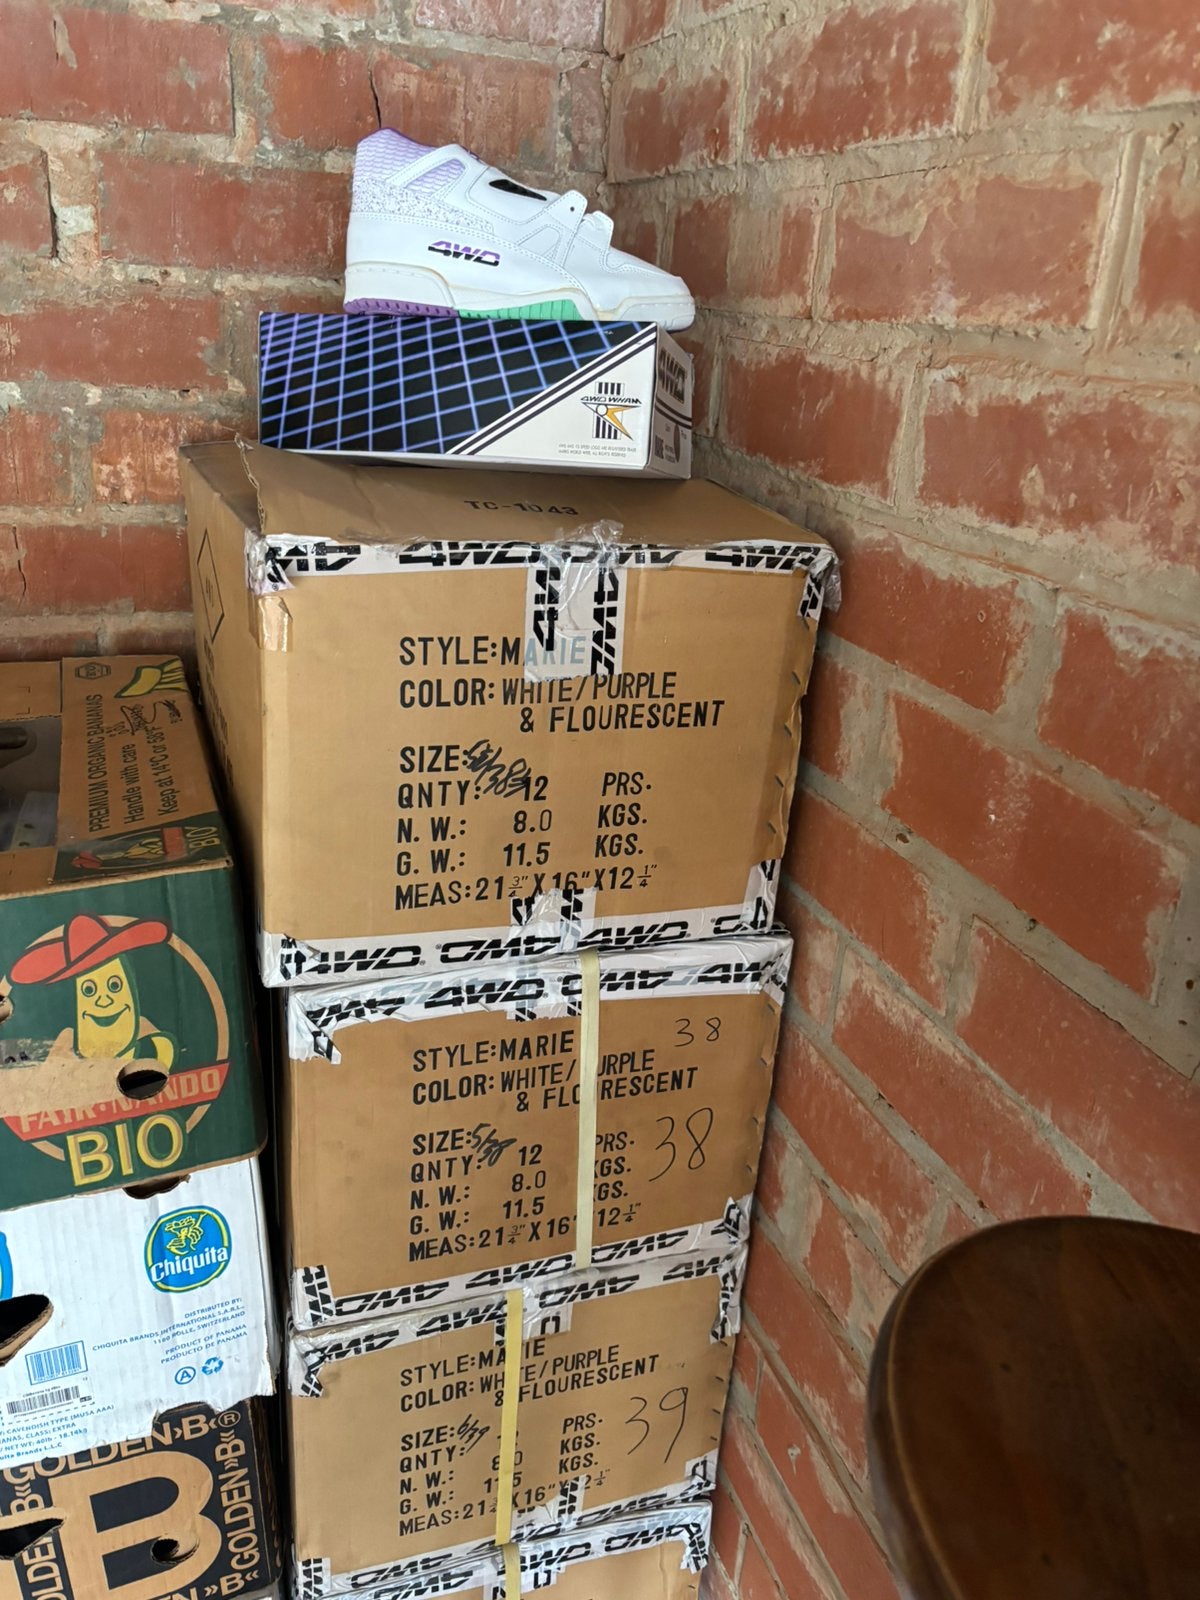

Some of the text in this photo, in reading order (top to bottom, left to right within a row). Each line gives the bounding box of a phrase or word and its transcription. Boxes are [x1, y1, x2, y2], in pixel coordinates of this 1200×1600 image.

[464, 500, 579, 516] TC-1043
[399, 678, 495, 709] COLOR:
[519, 700, 725, 733] & FLOURESCENT
[86, 694, 111, 832] PREMIUM ORGANIC BANANAS
[153, 743, 167, 754] or
[399, 744, 468, 774] SIZE:
[120, 743, 145, 824] Handle with care
[155, 776, 173, 789] at
[397, 771, 652, 809] QNTY: 12 PRS.
[157, 788, 182, 816] Keep
[186, 826, 220, 849] BIO
[396, 817, 420, 843] N.
[512, 809, 552, 834] 8.0
[597, 802, 647, 829] KGS.
[396, 851, 420, 876] G.
[502, 841, 551, 868] 11.5
[593, 832, 644, 858] KGS.
[674, 1016, 722, 1047] 38
[412, 1074, 494, 1105] COLOR:
[516, 1066, 699, 1112] & FLORESCENT
[66, 1113, 184, 1187] BIO
[412, 1128, 472, 1156] SIZE:
[649, 1107, 714, 1183] 38
[411, 1154, 482, 1183] QNTY:
[518, 1144, 543, 1167] 12
[410, 1190, 430, 1210] N.
[511, 1170, 546, 1193] 8.0
[409, 1214, 430, 1236] G.
[502, 1196, 545, 1220] 11.5
[593, 1180, 629, 1202] GS.
[150, 1246, 229, 1283] Chiquita
[184, 1301, 230, 1319] DISTRIBUTED
[197, 1310, 246, 1331] SWITZERLAND
[92, 1339, 128, 1351] CHIQUITA
[129, 1331, 159, 1343] BRANDS
[159, 1313, 217, 1336] INTERNATIONAL
[160, 1331, 248, 1365] PRODUCTO DE PANAMA
[165, 1323, 247, 1355] PRODUCT OF PANAMA
[518, 1354, 660, 1403] FLOURESCENT
[400, 1380, 474, 1413] COLOR:
[6, 1422, 51, 1435] CAVENDISH
[51, 1416, 71, 1426] TYPE
[52, 1422, 77, 1432] EXTRA
[400, 1424, 455, 1452] SIZE:
[625, 1386, 689, 1464] 39
[5, 1443, 19, 1452] NET
[16, 1448, 42, 1457] Brands
[399, 1412, 604, 1473] QNTY: PRS.
[560, 1432, 601, 1455] KGS.
[559, 1452, 599, 1475] KGS.
[218, 1467, 260, 1570] GOLDEN
